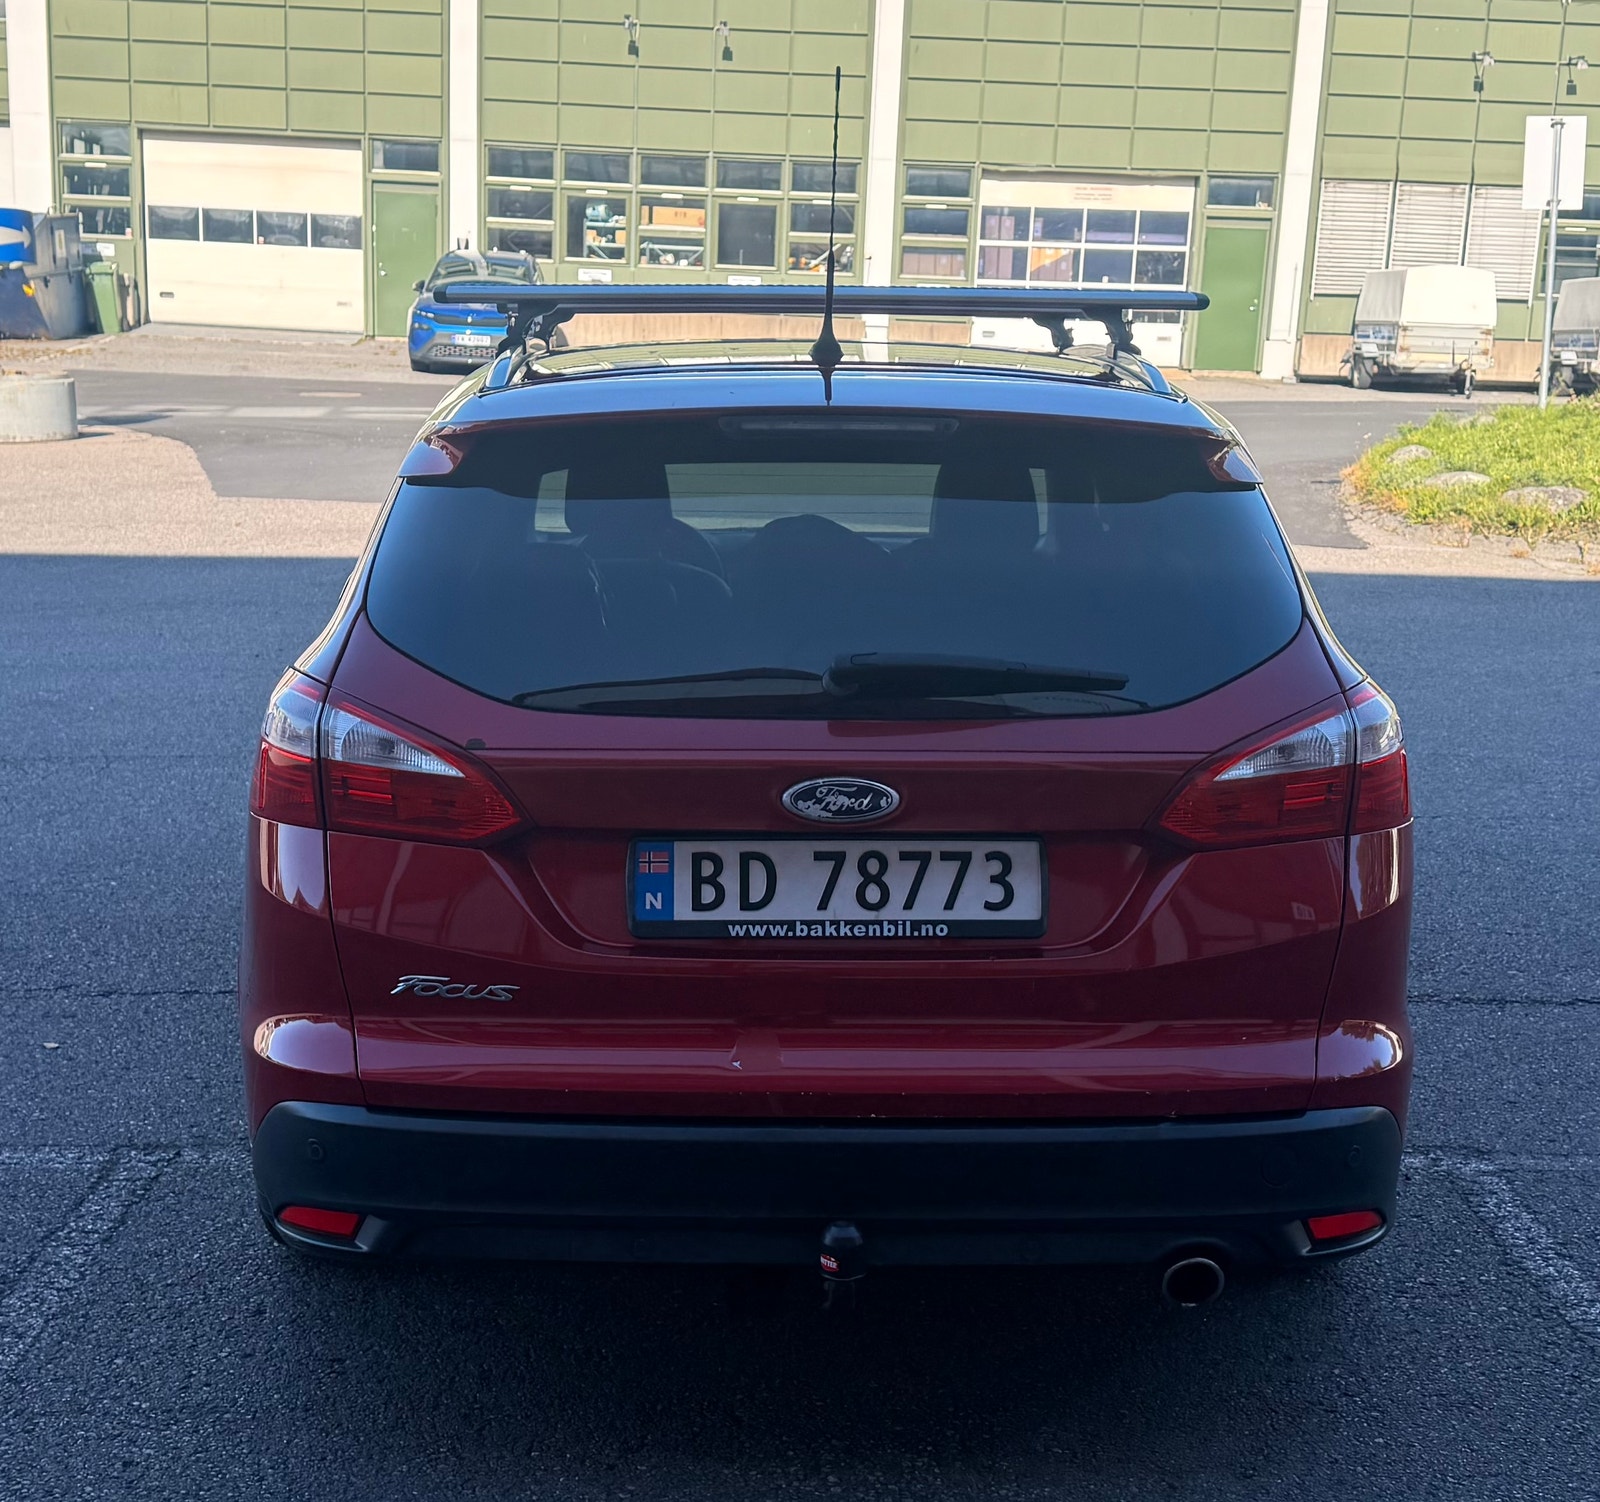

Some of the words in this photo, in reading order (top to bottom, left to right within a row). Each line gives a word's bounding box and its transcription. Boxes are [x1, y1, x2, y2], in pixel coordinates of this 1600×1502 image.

[815, 785, 873, 811] Ford
[690, 851, 778, 912] BD
[813, 850, 1015, 912] 78773
[645, 892, 662, 909] N
[728, 920, 949, 937] www.bakkenbil.no
